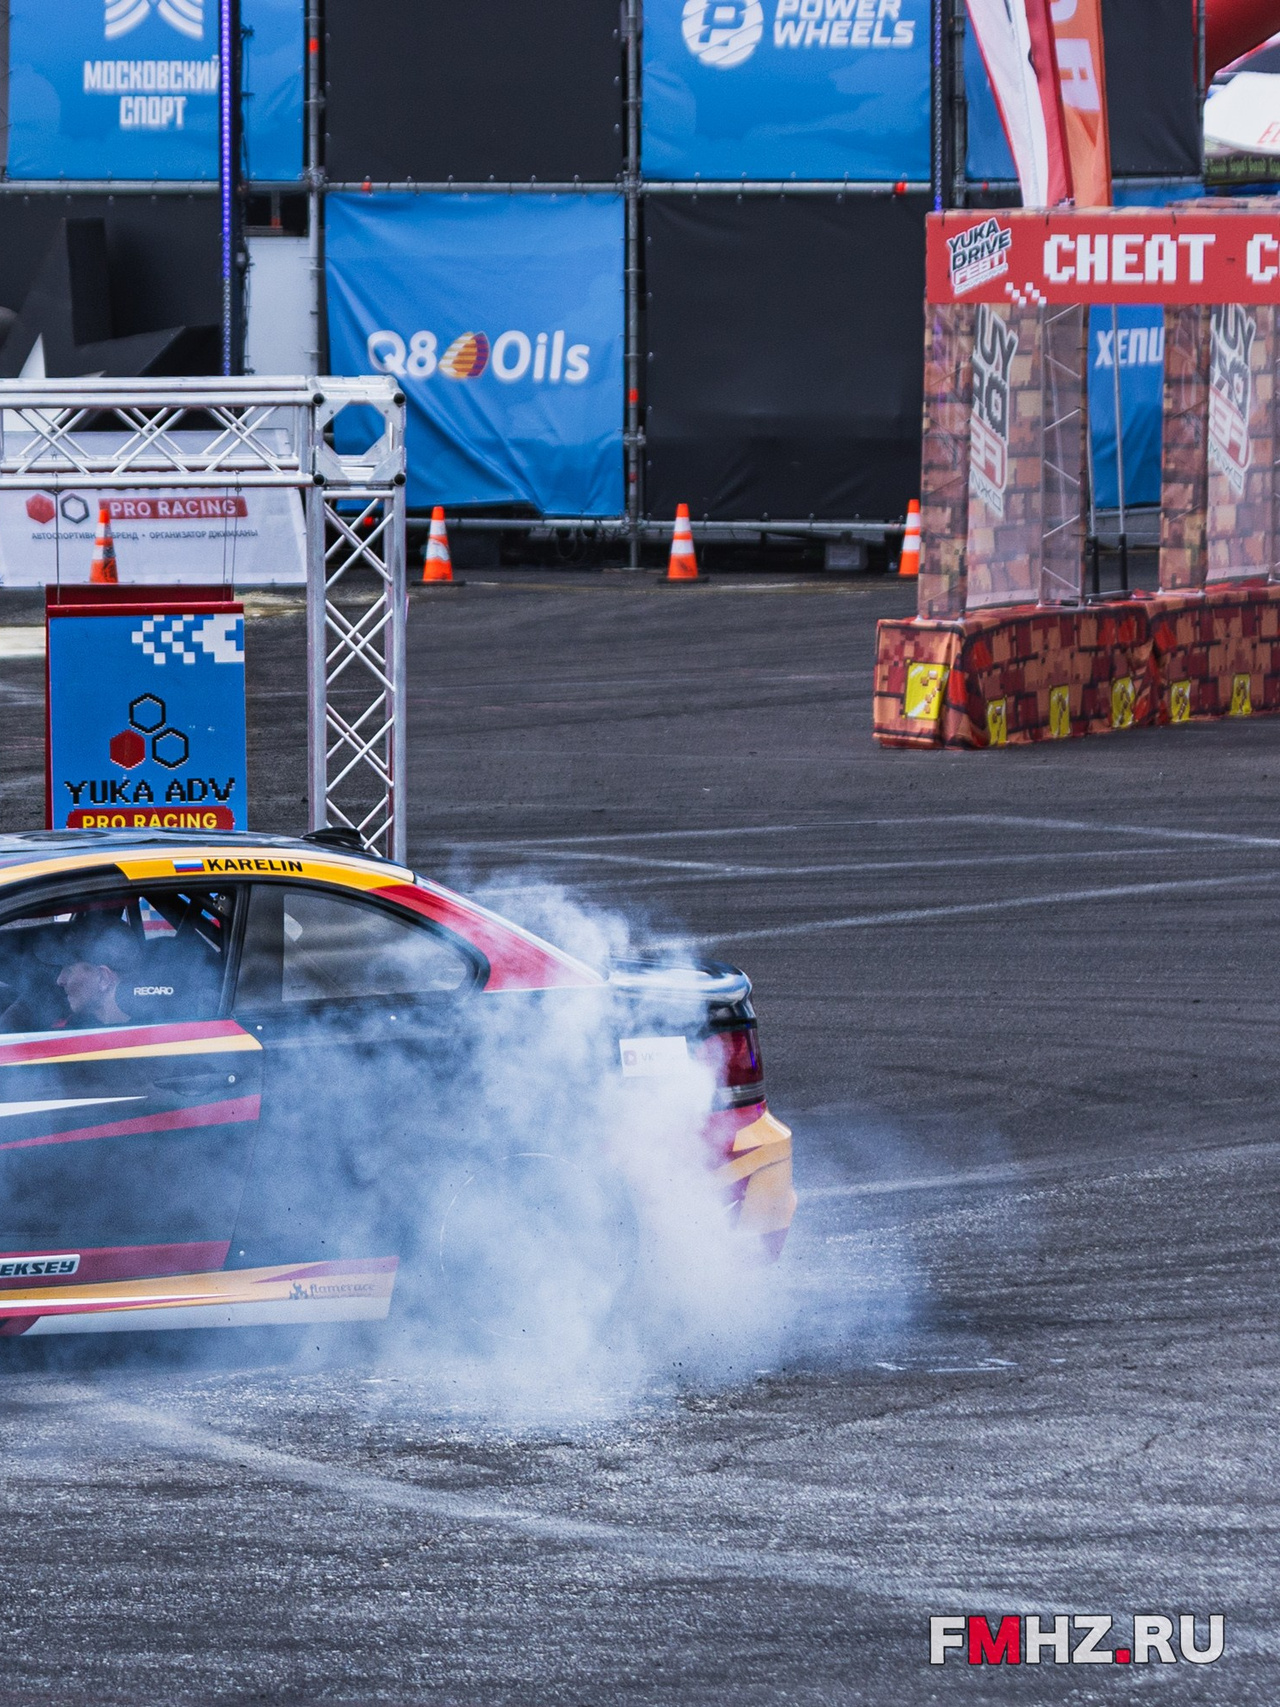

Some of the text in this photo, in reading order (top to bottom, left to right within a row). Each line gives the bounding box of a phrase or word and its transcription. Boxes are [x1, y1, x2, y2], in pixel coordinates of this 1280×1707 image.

[776, 0, 902, 19] POWER
[774, 20, 915, 46] WHEELS
[83, 55, 219, 91] МОСКОВСКИЙ
[120, 96, 186, 126] СПОРТ
[948, 219, 998, 252] YUKA
[953, 229, 1011, 270] DRIVE
[1043, 234, 1216, 282] CHEAT
[367, 330, 591, 381] Q8 Oils
[110, 499, 237, 516] PRO RACING
[31, 532, 97, 540] АВТОСПОРТИВН
[149, 530, 206, 540] ОРГАНИЗАТОР
[64, 777, 236, 806] YUKA ADV
[83, 812, 218, 828] PRO RACING
[207, 859, 303, 872] KARELIN
[133, 986, 174, 996] RECARO
